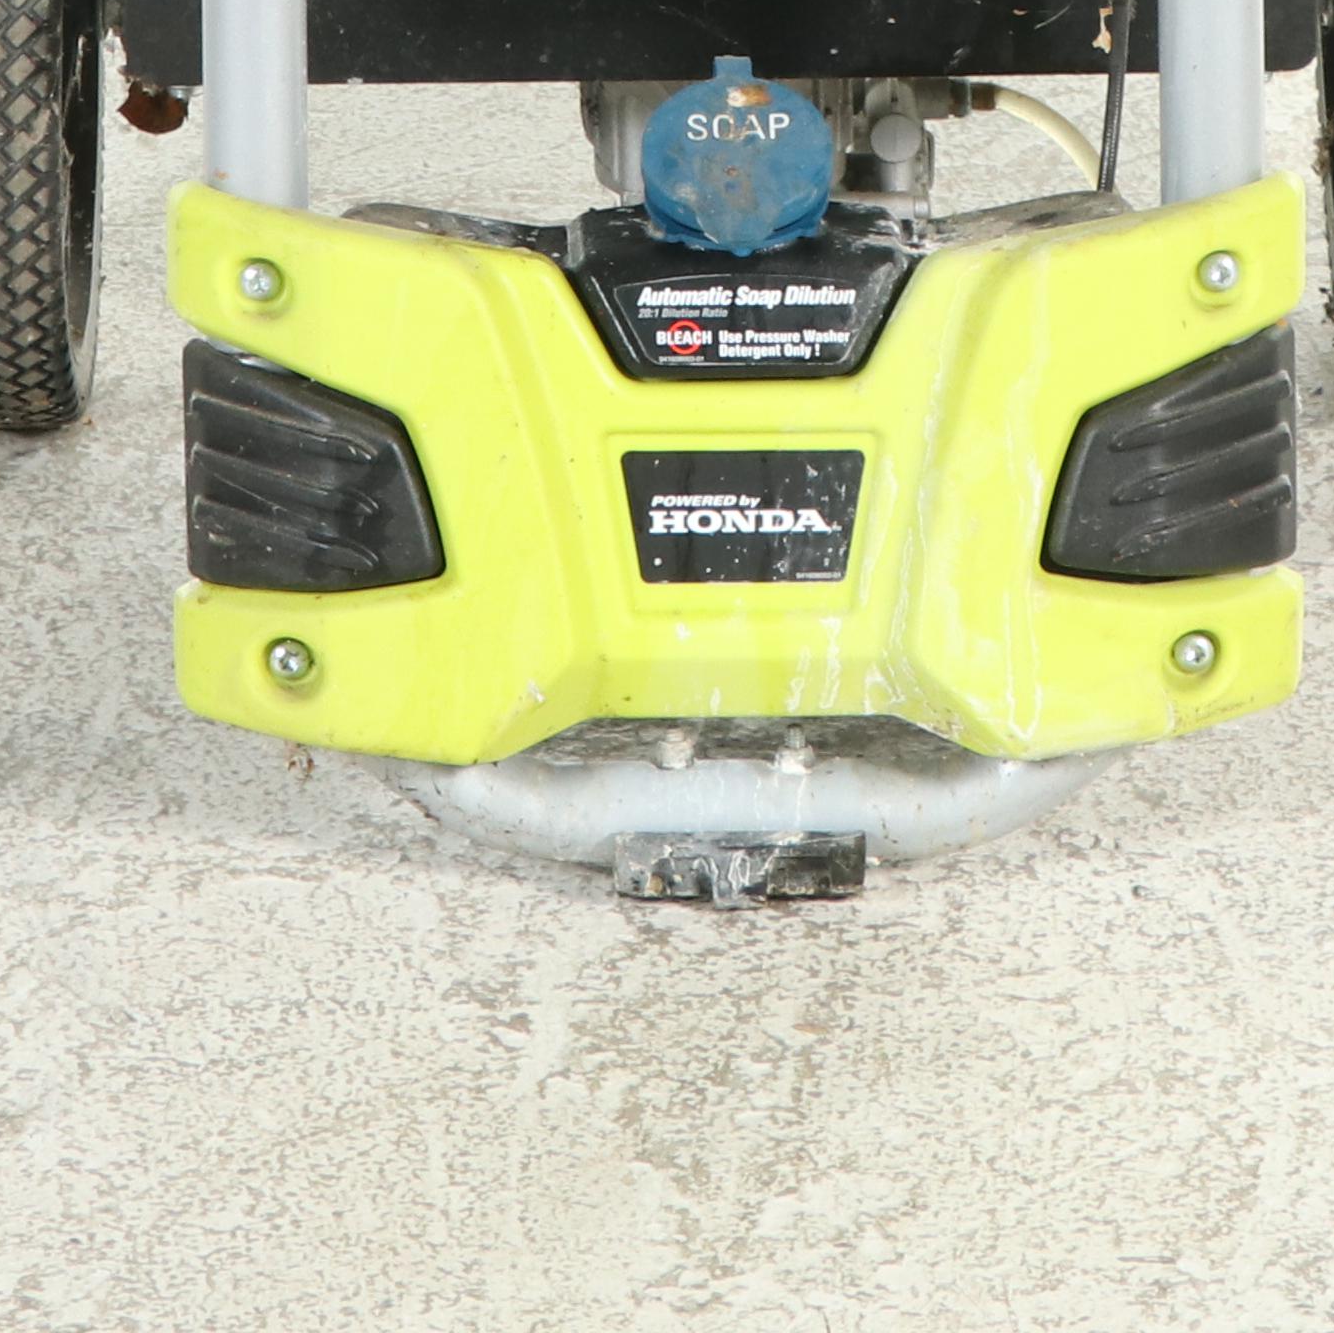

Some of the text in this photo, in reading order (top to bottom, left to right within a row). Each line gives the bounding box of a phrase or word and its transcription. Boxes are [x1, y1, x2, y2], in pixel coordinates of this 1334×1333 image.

[687, 113, 790, 141] SOAP
[637, 285, 856, 309] Automatic Soap Dilution
[661, 308, 700, 318] Dilution
[701, 308, 729, 318] Ratio
[655, 330, 713, 346] BLEACH
[718, 329, 851, 344] Use Pressure Washer
[718, 344, 782, 359] Detergent
[783, 344, 812, 359] Only
[651, 495, 761, 508] POWERED by
[648, 509, 832, 534] HONDA
